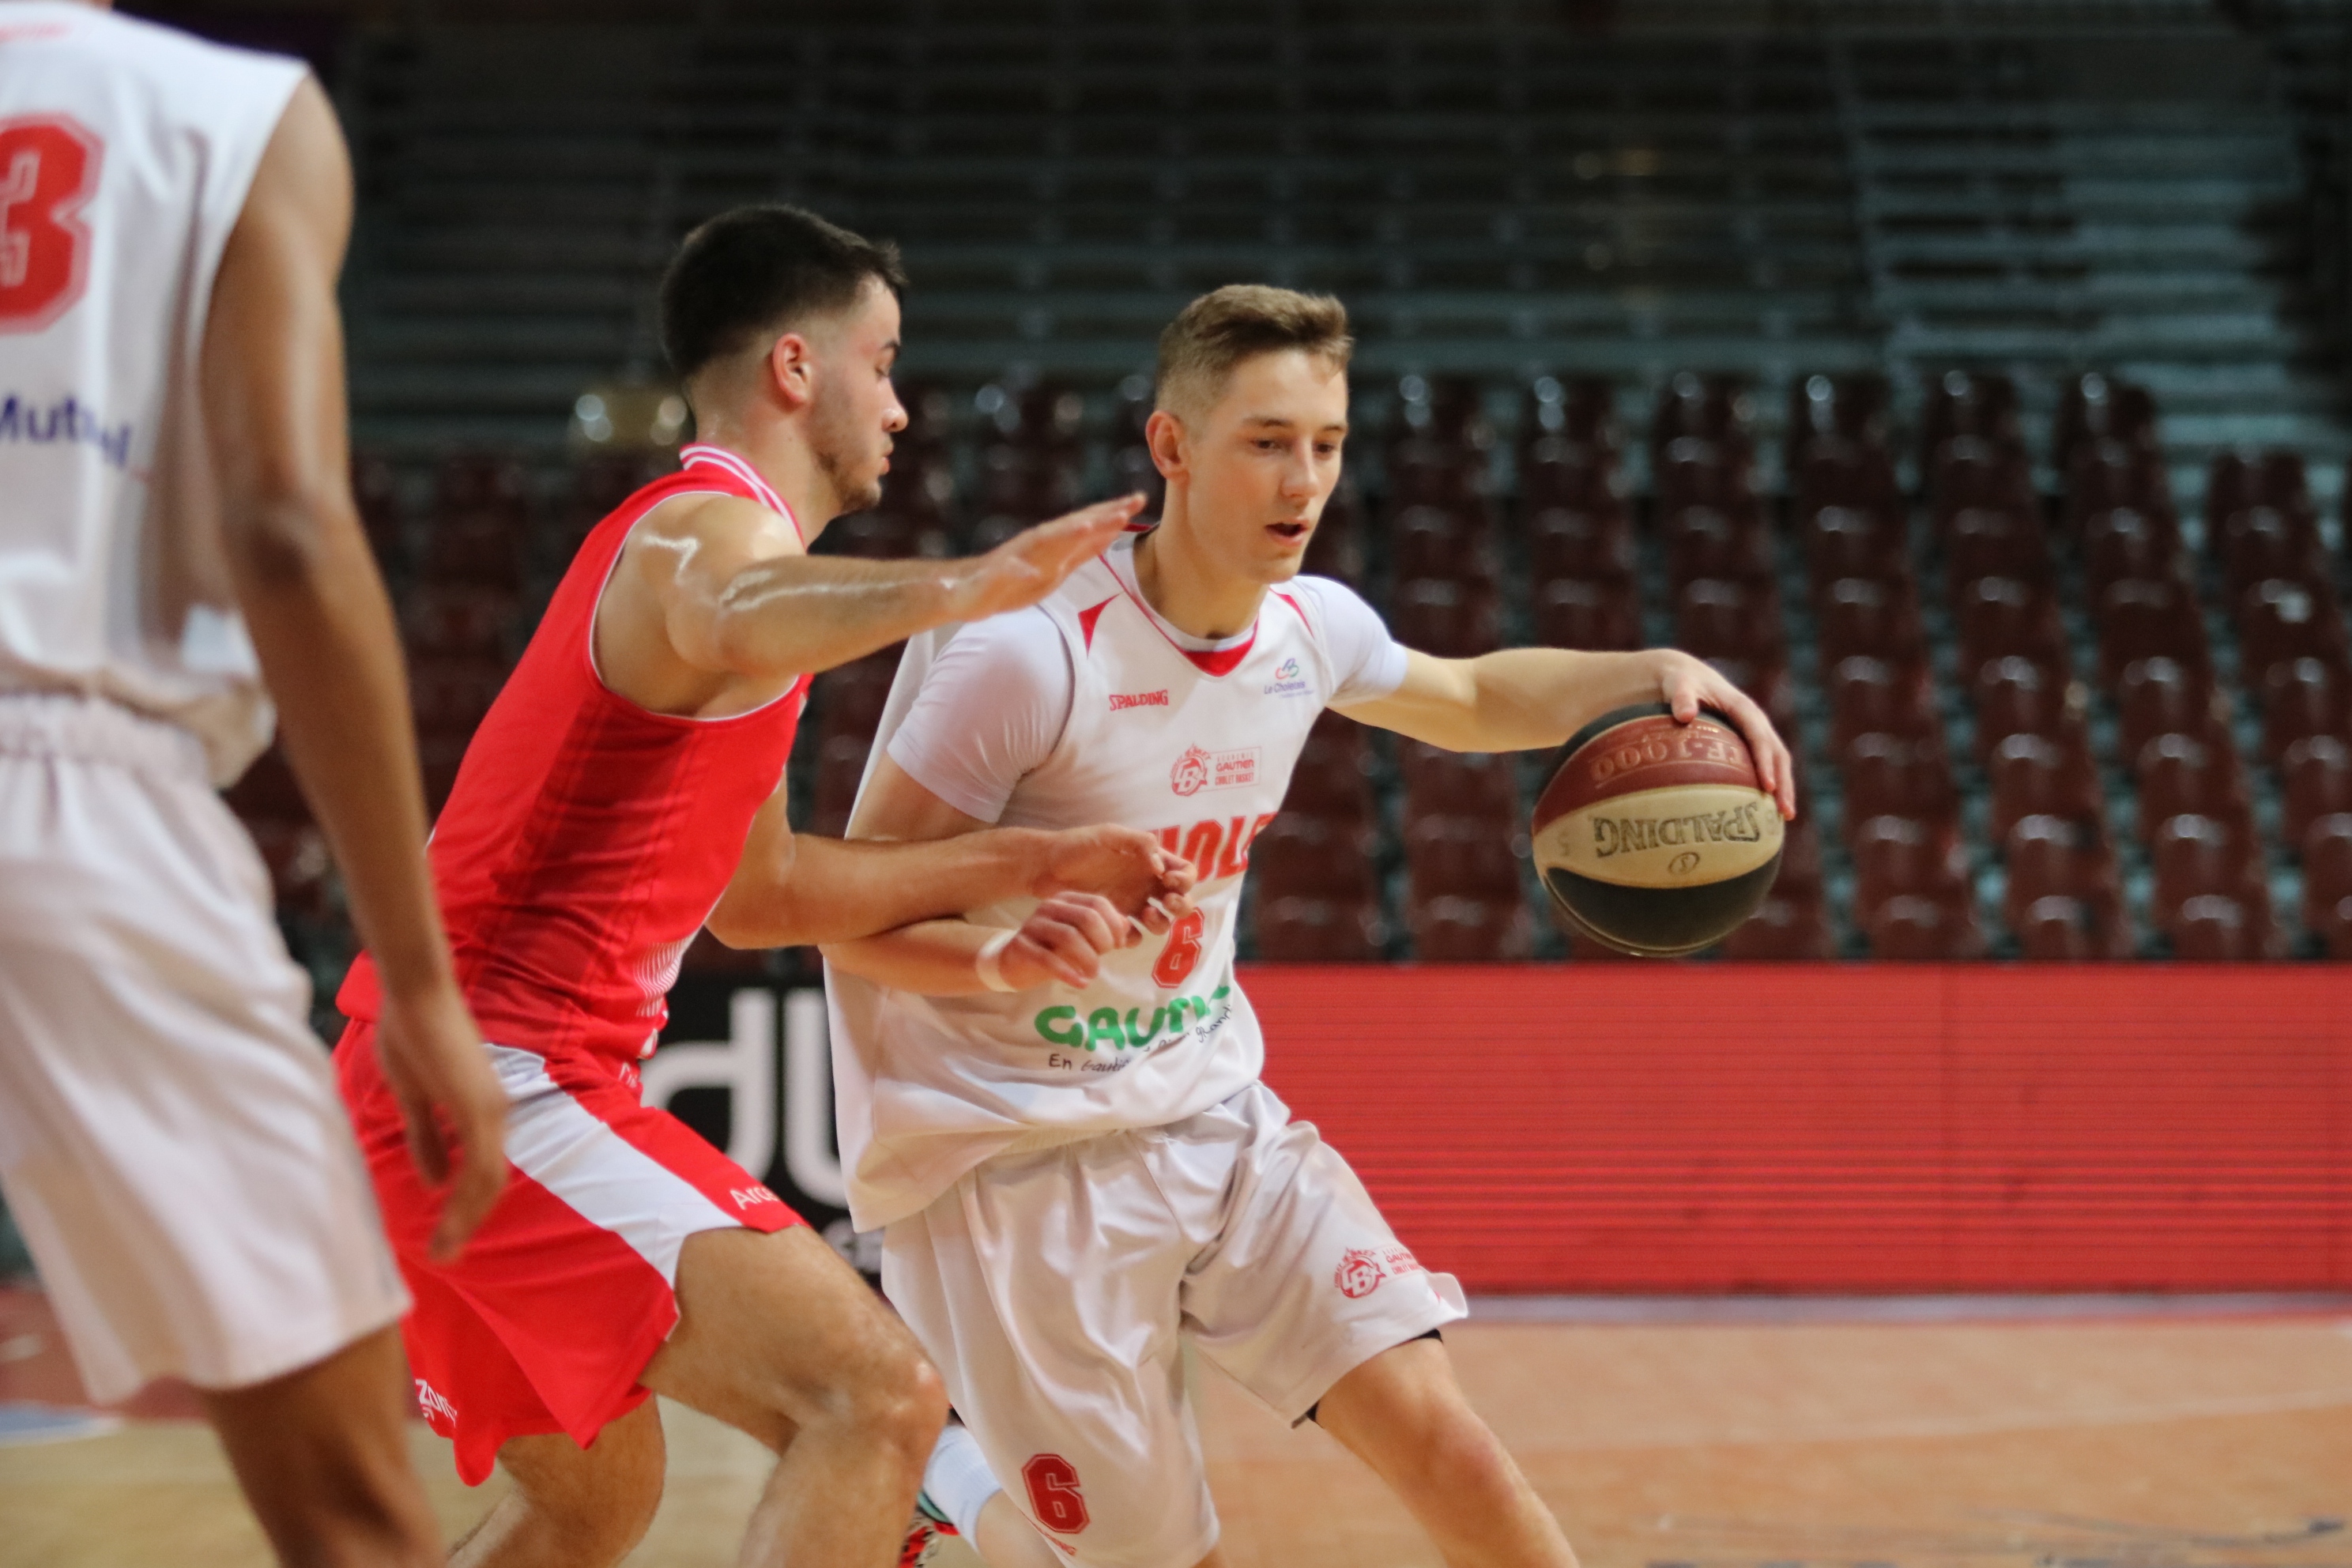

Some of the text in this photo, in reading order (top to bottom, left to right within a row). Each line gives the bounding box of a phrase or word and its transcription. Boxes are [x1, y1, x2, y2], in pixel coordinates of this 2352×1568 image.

[1108, 689, 1169, 711] SPALDING
[1592, 801, 1761, 858] SPALDING
[1152, 906, 1205, 989] 6
[1048, 1054, 1073, 1068] En
[1021, 1453, 1091, 1534] 6
